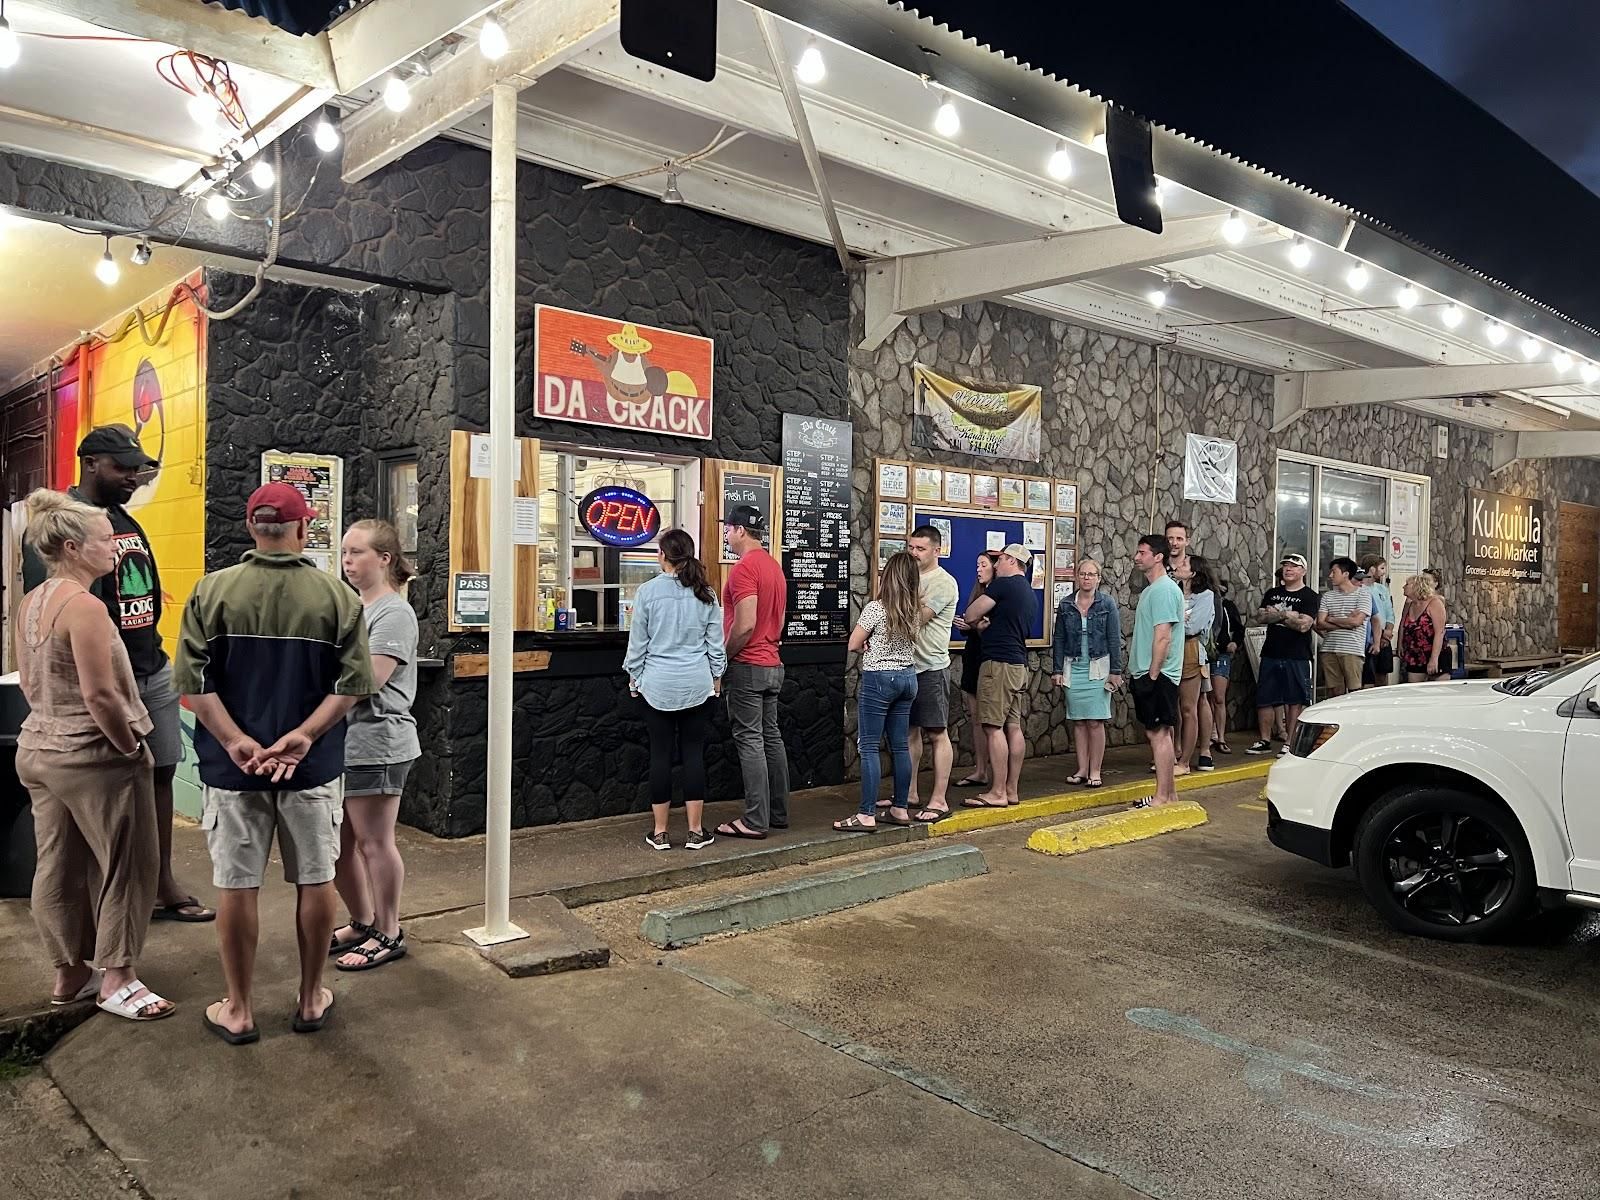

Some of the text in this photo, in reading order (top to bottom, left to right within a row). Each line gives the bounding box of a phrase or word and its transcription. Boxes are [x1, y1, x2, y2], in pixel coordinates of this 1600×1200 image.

[544, 374, 705, 435] DA CRACK
[724, 489, 757, 501] Fresh Fish
[586, 500, 654, 534] OPEN
[889, 511, 904, 519] PAINT
[1474, 540, 1538, 562] Local Market
[460, 579, 488, 589] PASS
[119, 598, 154, 617] LODG
